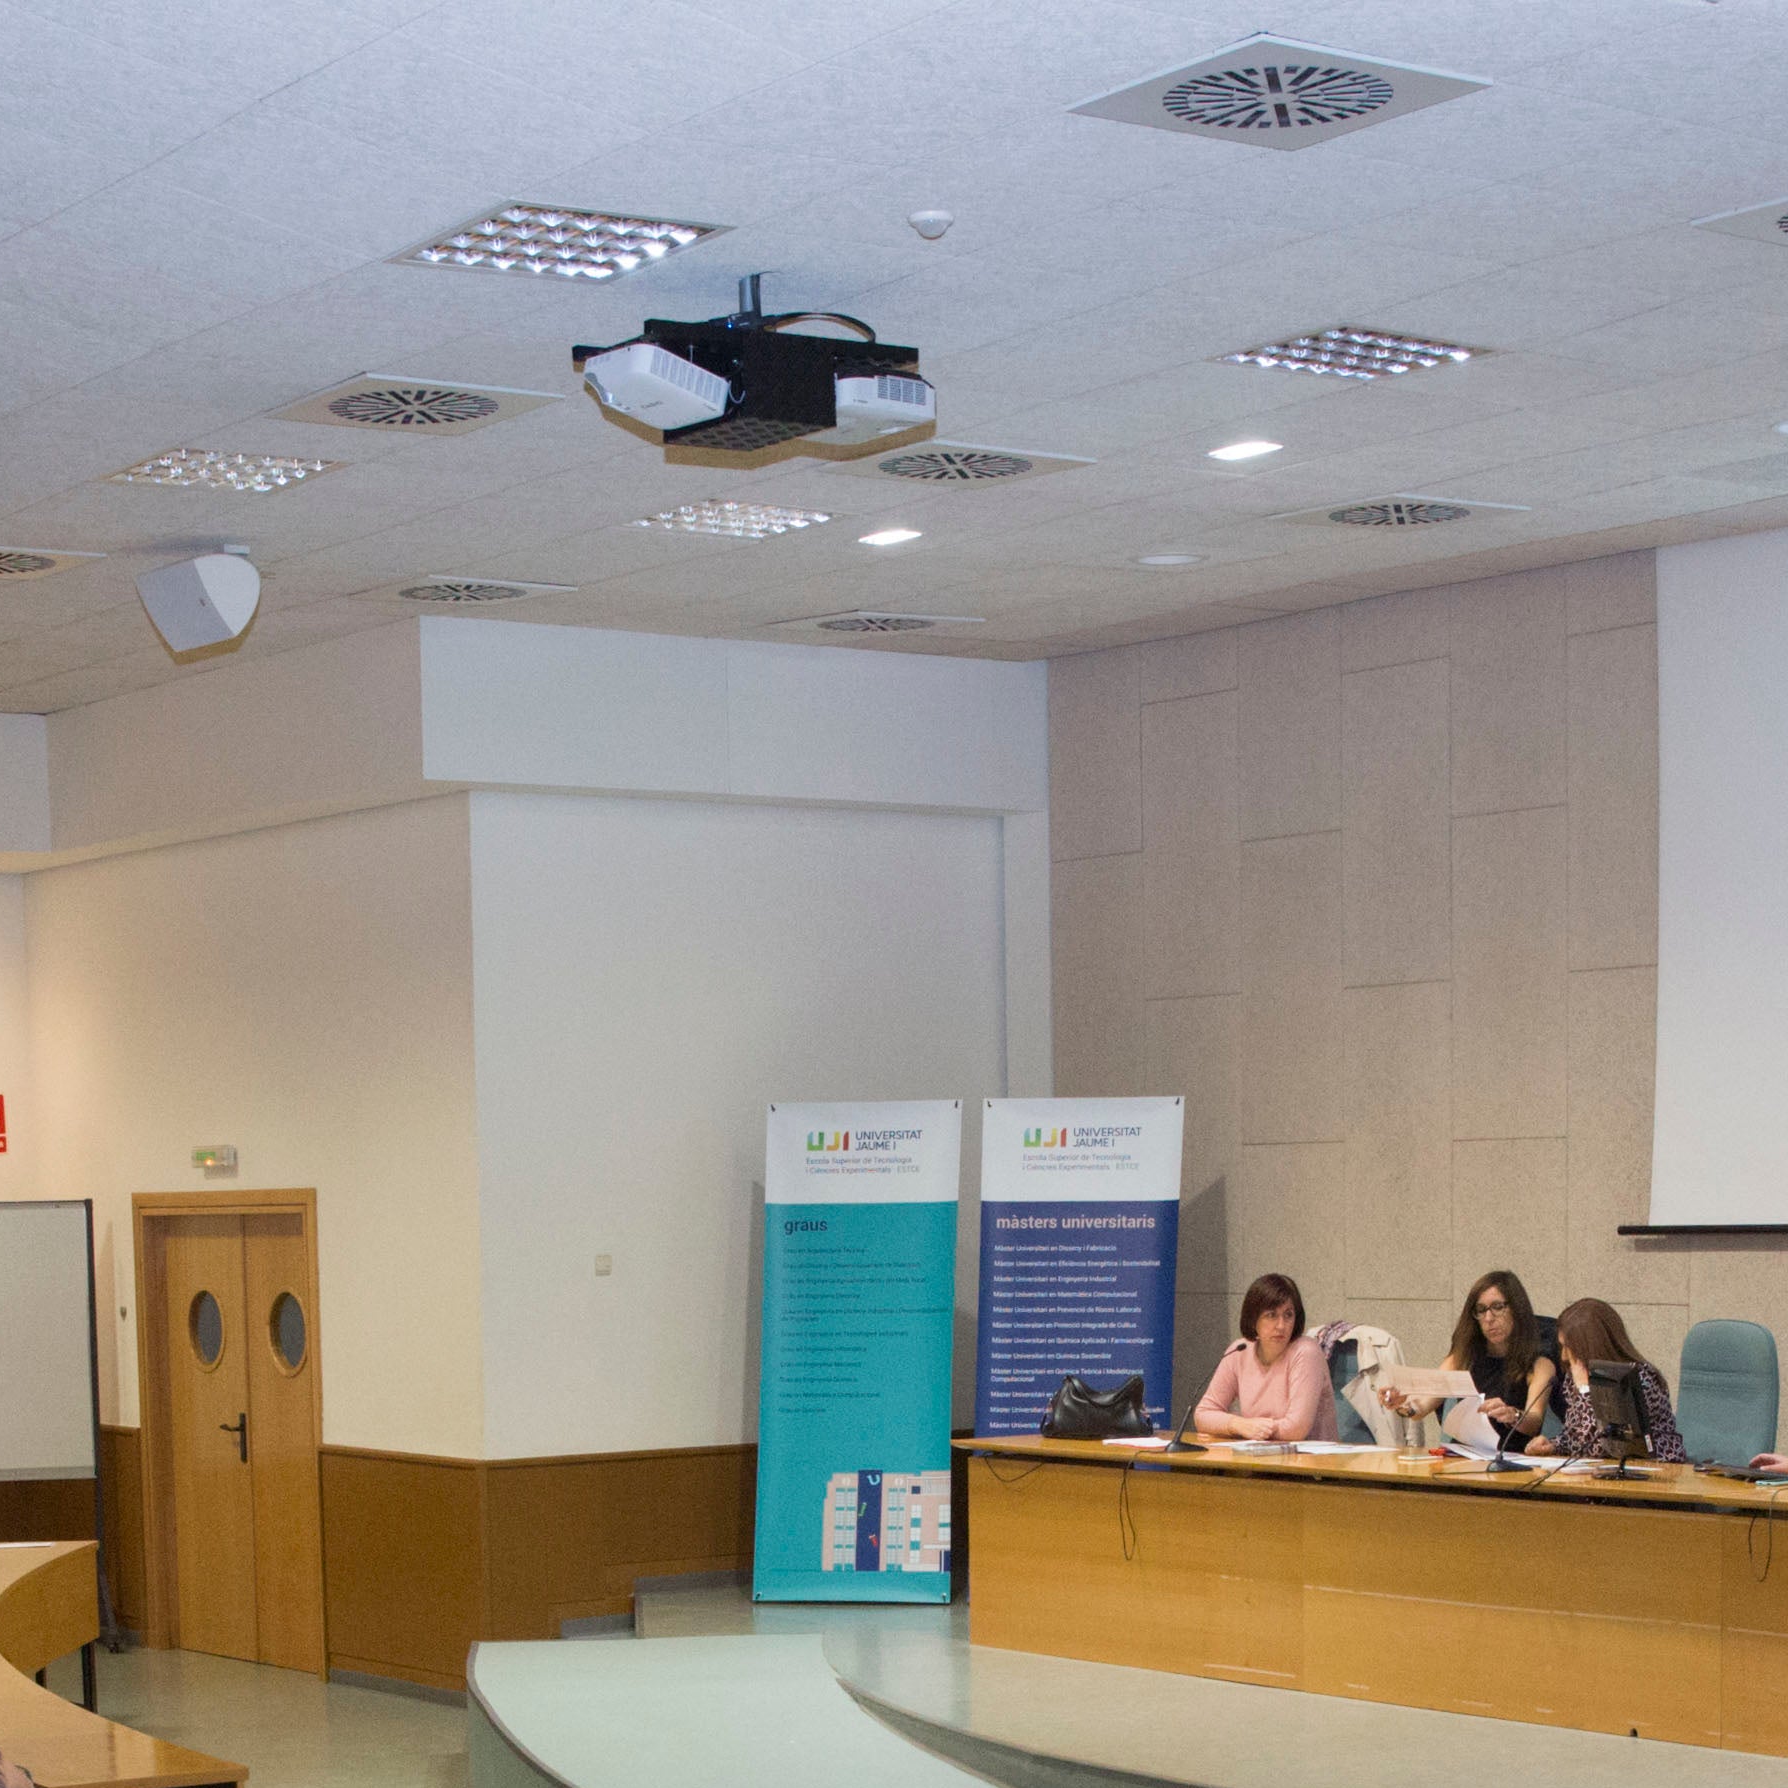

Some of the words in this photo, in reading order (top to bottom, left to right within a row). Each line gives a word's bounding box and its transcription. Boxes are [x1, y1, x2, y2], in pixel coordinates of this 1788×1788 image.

[855, 1129, 923, 1140] UNIVERSITAT
[1023, 1127, 1067, 1147] UJI
[1073, 1126, 1142, 1137] UNIVERSITAT
[807, 1131, 849, 1151] UJI
[855, 1141, 890, 1151] JAUME
[1073, 1138, 1109, 1147] JAUME
[784, 1219, 828, 1235] graus
[996, 1214, 1057, 1229] màsters
[1062, 1214, 1155, 1229] universitaris
